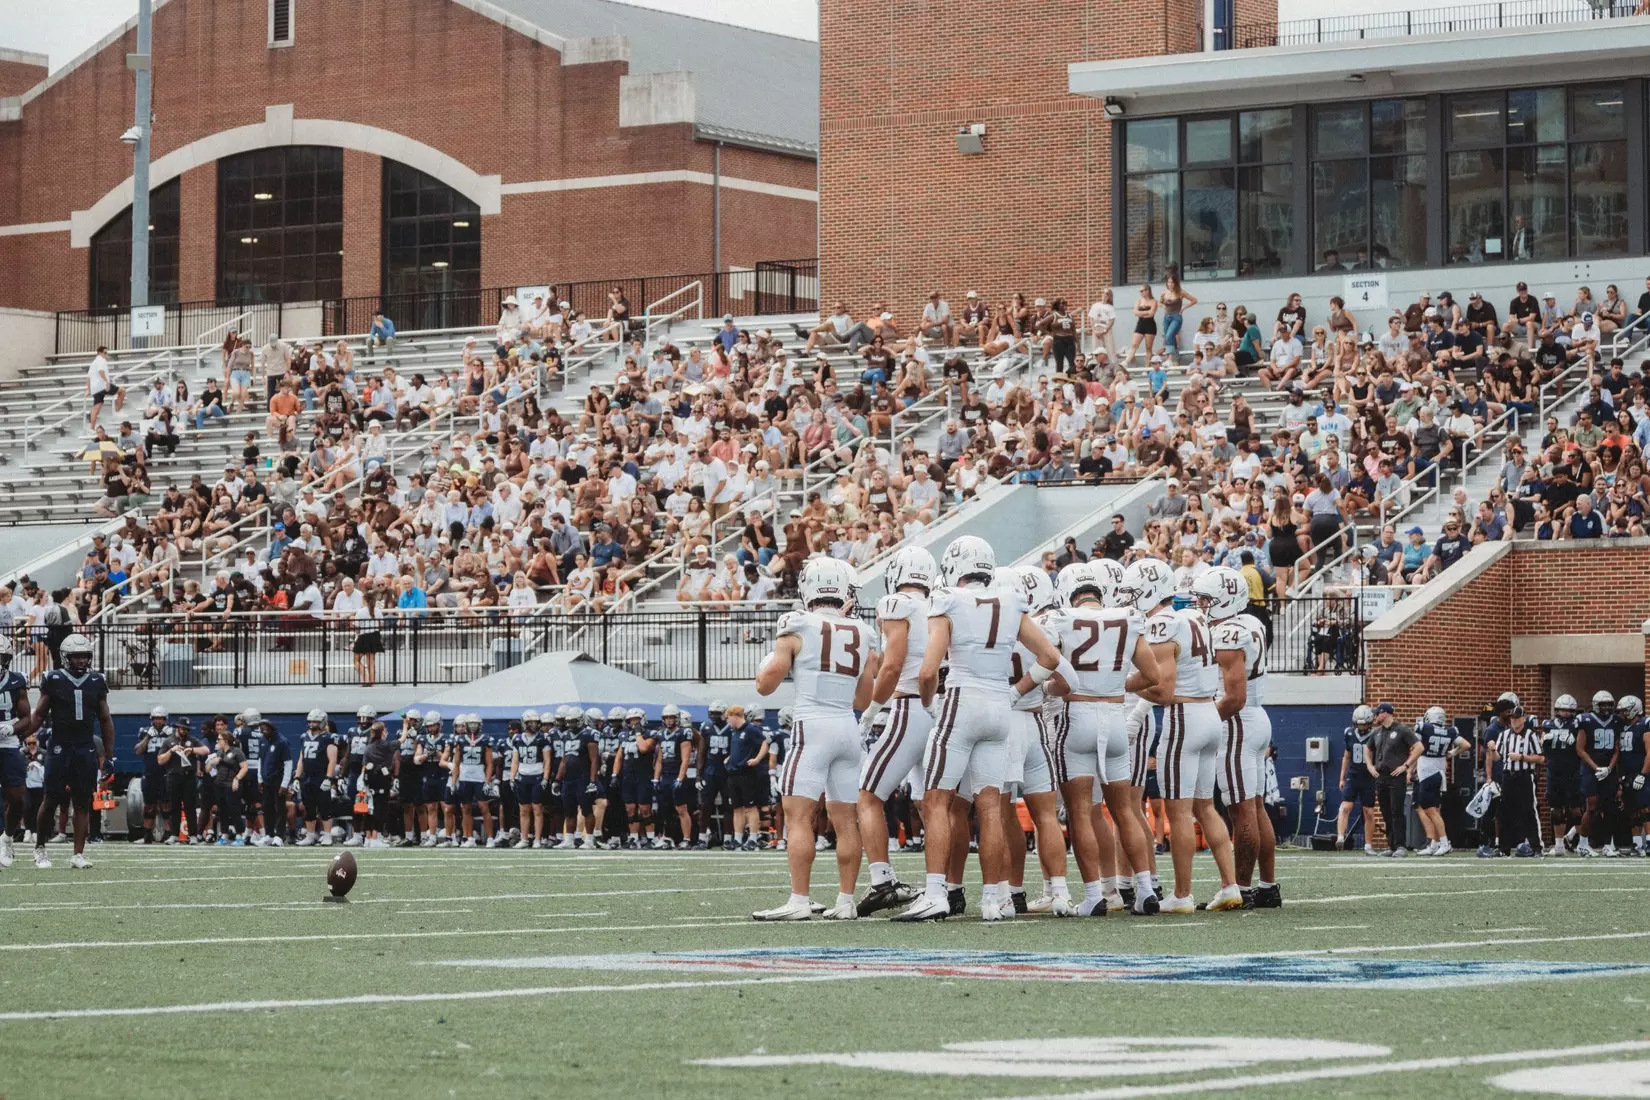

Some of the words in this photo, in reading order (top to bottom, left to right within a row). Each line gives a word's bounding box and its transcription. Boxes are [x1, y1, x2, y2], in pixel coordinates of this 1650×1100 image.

[1351, 280, 1380, 288] SECTION
[1362, 291, 1369, 301] 4
[145, 321, 150, 330] 1
[886, 599, 898, 613] 17
[975, 597, 1001, 649] 7
[1150, 622, 1167, 637] 42
[1070, 618, 1129, 672] 27
[1222, 629, 1239, 644] 24
[820, 620, 861, 677] 13
[74, 689, 84, 720] 1
[1594, 728, 1615, 750] 90
[303, 740, 320, 759] 72
[463, 746, 482, 765] 25
